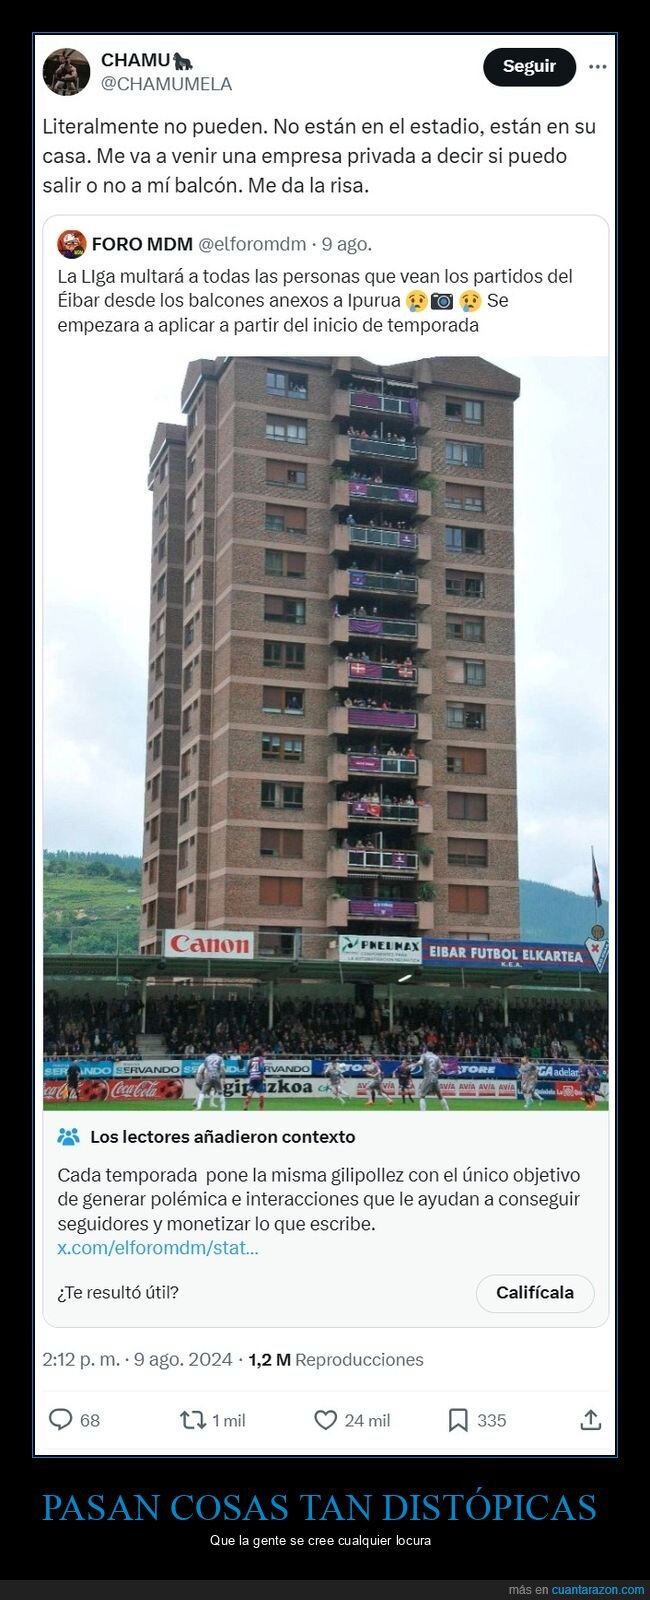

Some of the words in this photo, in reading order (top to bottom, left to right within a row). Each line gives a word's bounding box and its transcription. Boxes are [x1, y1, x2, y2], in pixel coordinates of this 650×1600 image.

[170, 934, 250, 953] Canon
[361, 940, 420, 952] PNEUMAX
[429, 945, 467, 959] EIBAR
[470, 947, 519, 960] FUTBOL
[522, 949, 584, 963] ELKARTEA
[116, 1065, 180, 1074] SERVANDO
[111, 1080, 161, 1098] Coca-Cola
